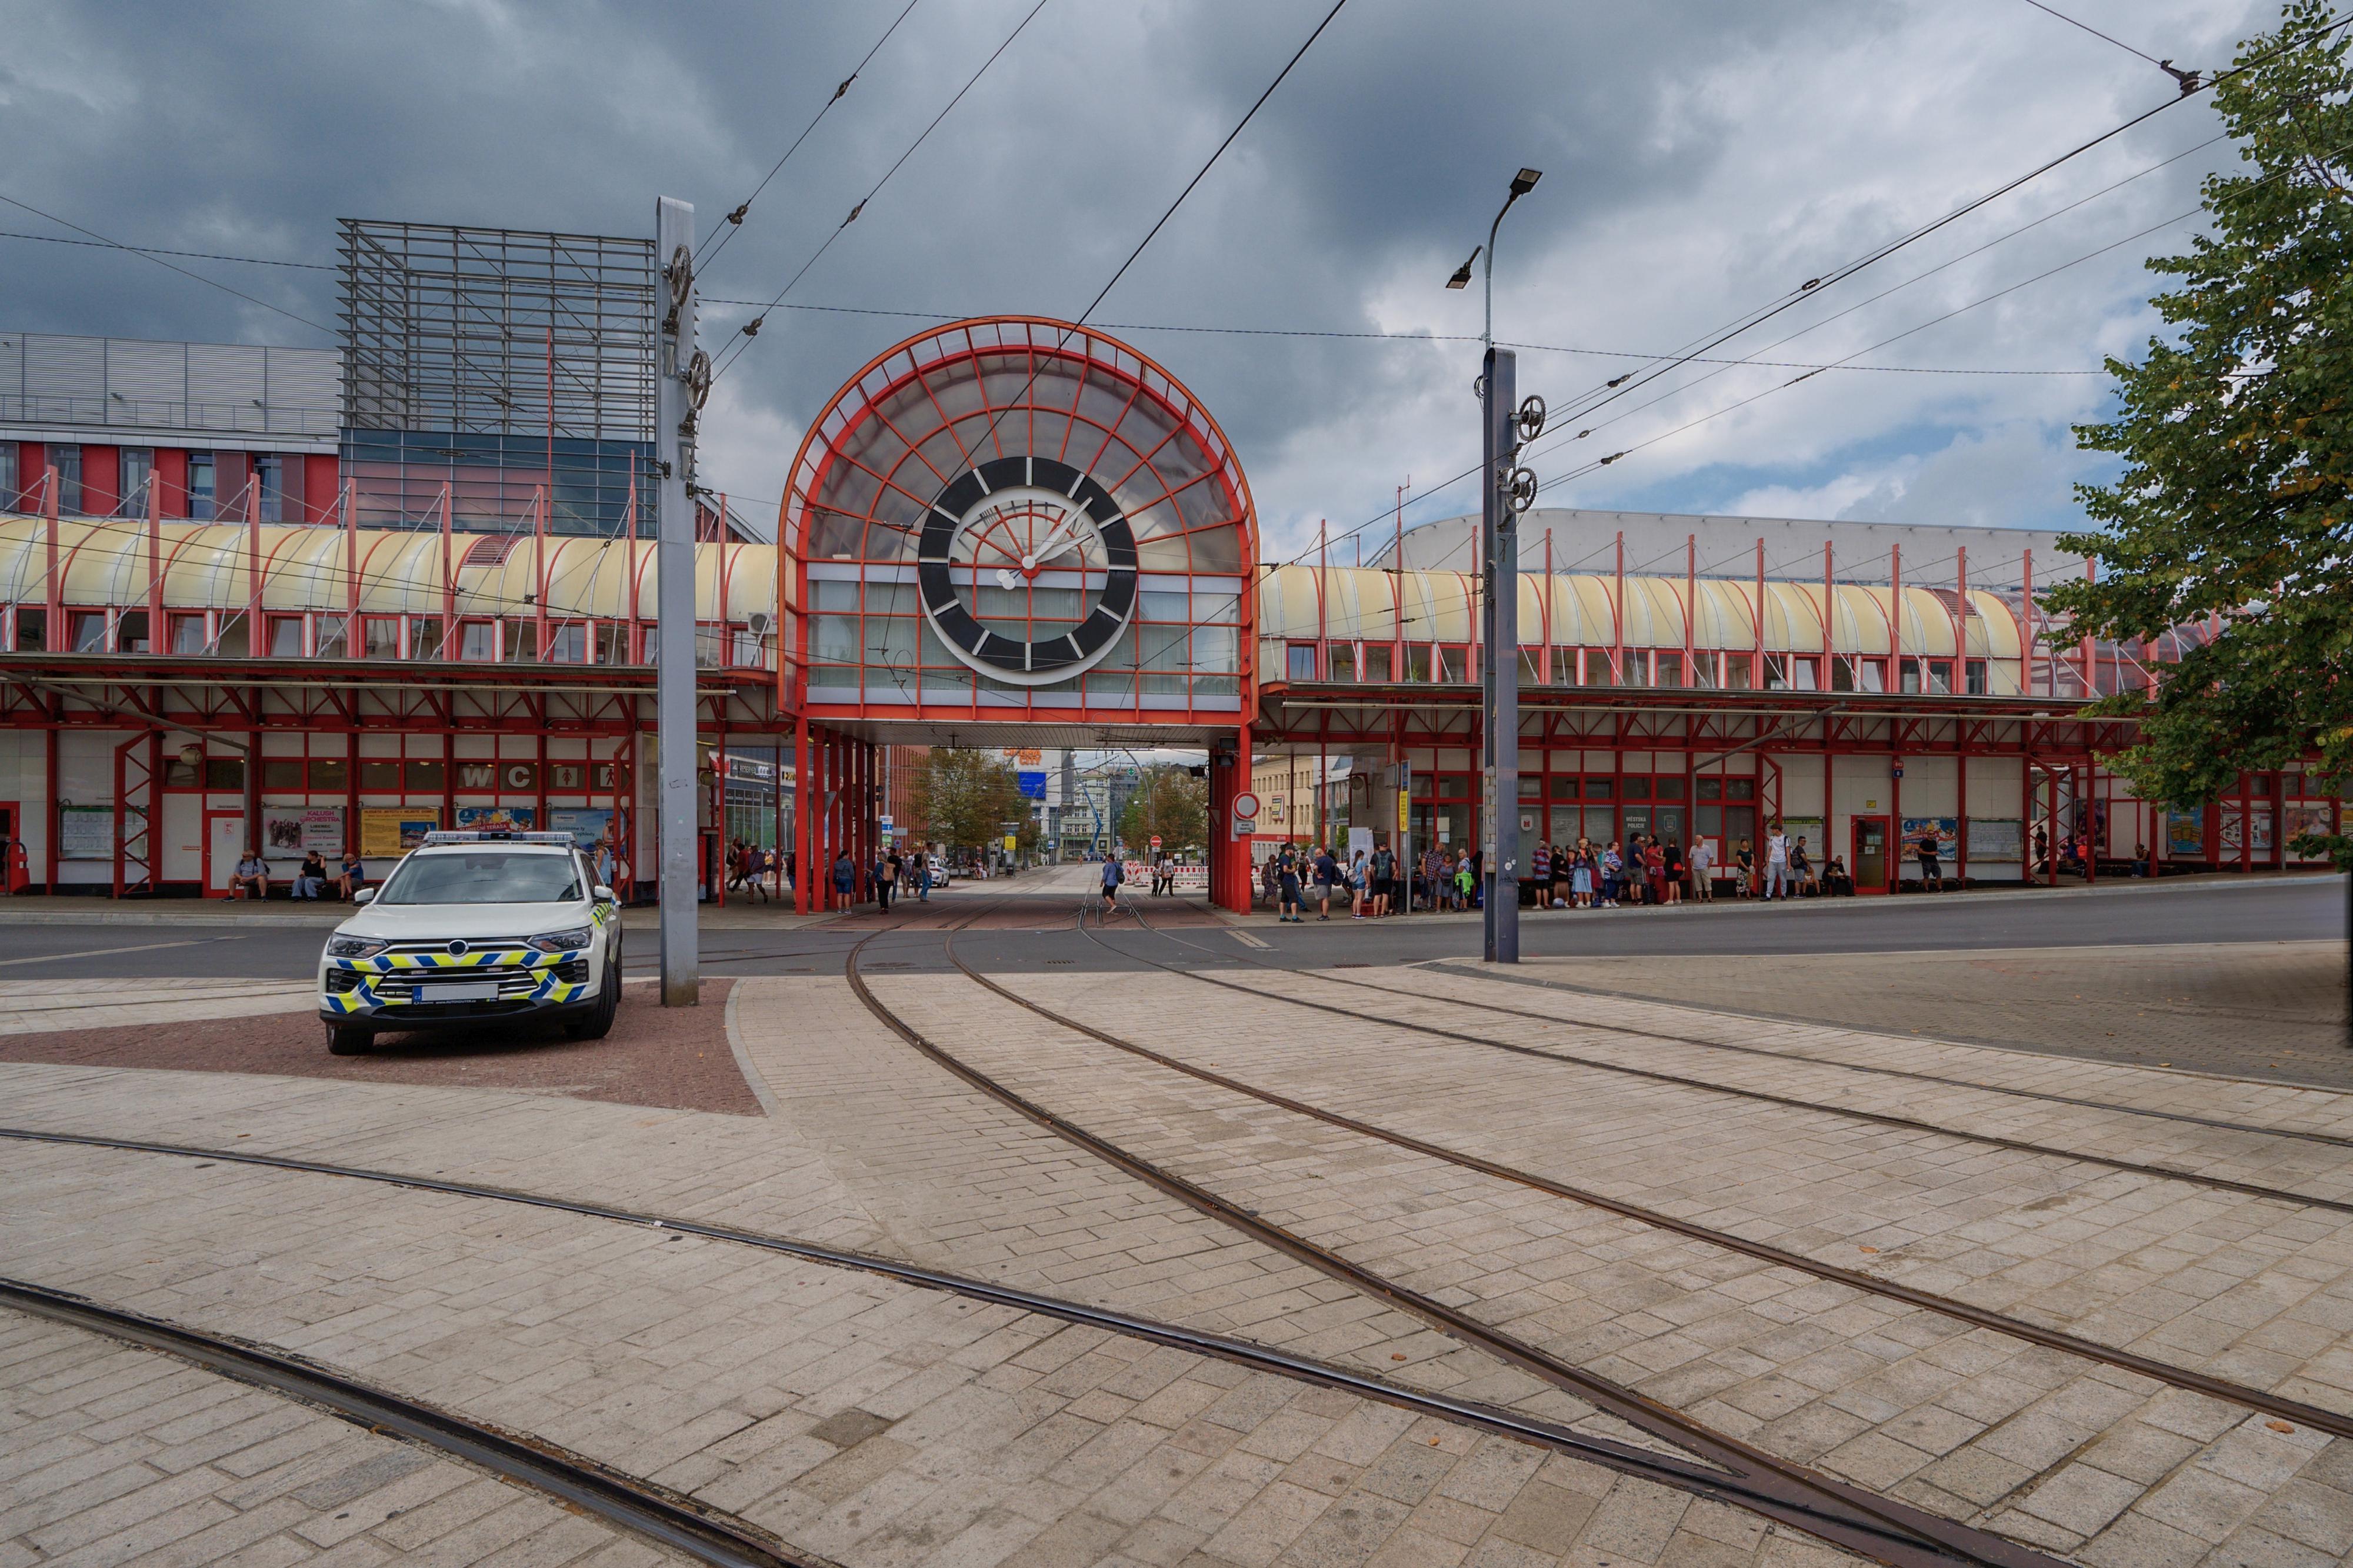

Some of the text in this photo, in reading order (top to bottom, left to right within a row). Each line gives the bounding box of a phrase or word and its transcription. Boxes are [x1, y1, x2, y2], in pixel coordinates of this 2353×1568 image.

[1019, 756, 1041, 765] CITY
[739, 765, 756, 775] RESERVED
[463, 766, 530, 788] WC
